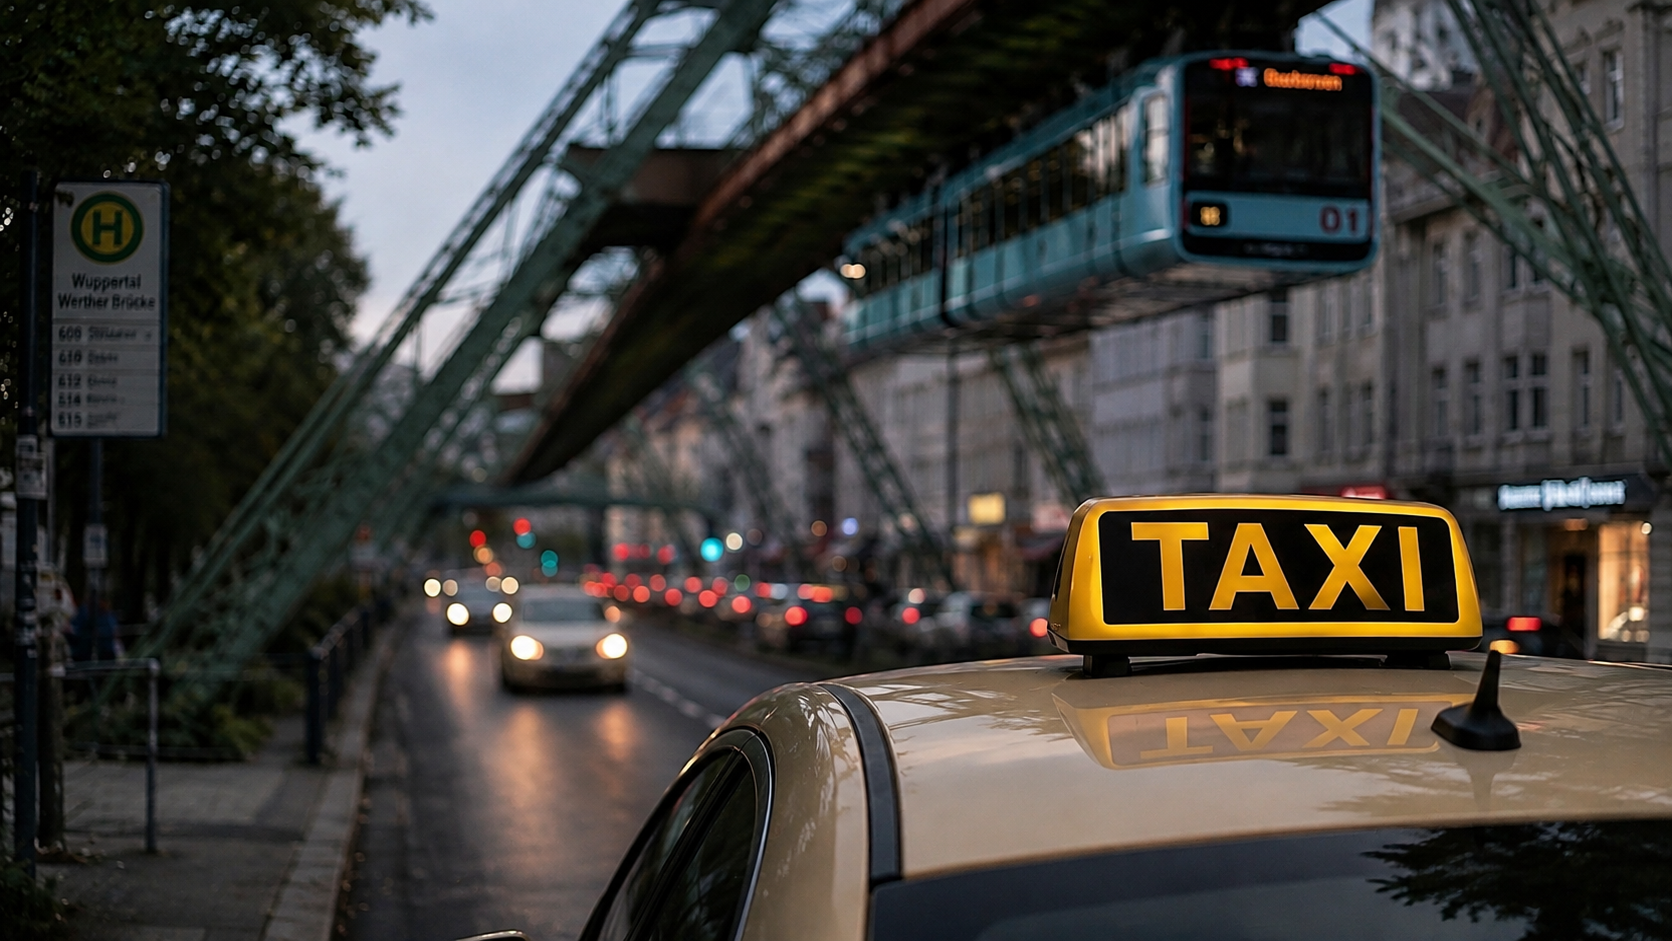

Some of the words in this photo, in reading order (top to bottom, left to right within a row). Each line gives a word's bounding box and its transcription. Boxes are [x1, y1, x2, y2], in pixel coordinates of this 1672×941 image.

[92, 209, 123, 246] H
[1319, 205, 1358, 234] 01
[71, 272, 142, 292] Wuppertal
[57, 293, 109, 309] Werther
[112, 293, 156, 310] Brücke
[1130, 521, 1426, 612] TAXI
